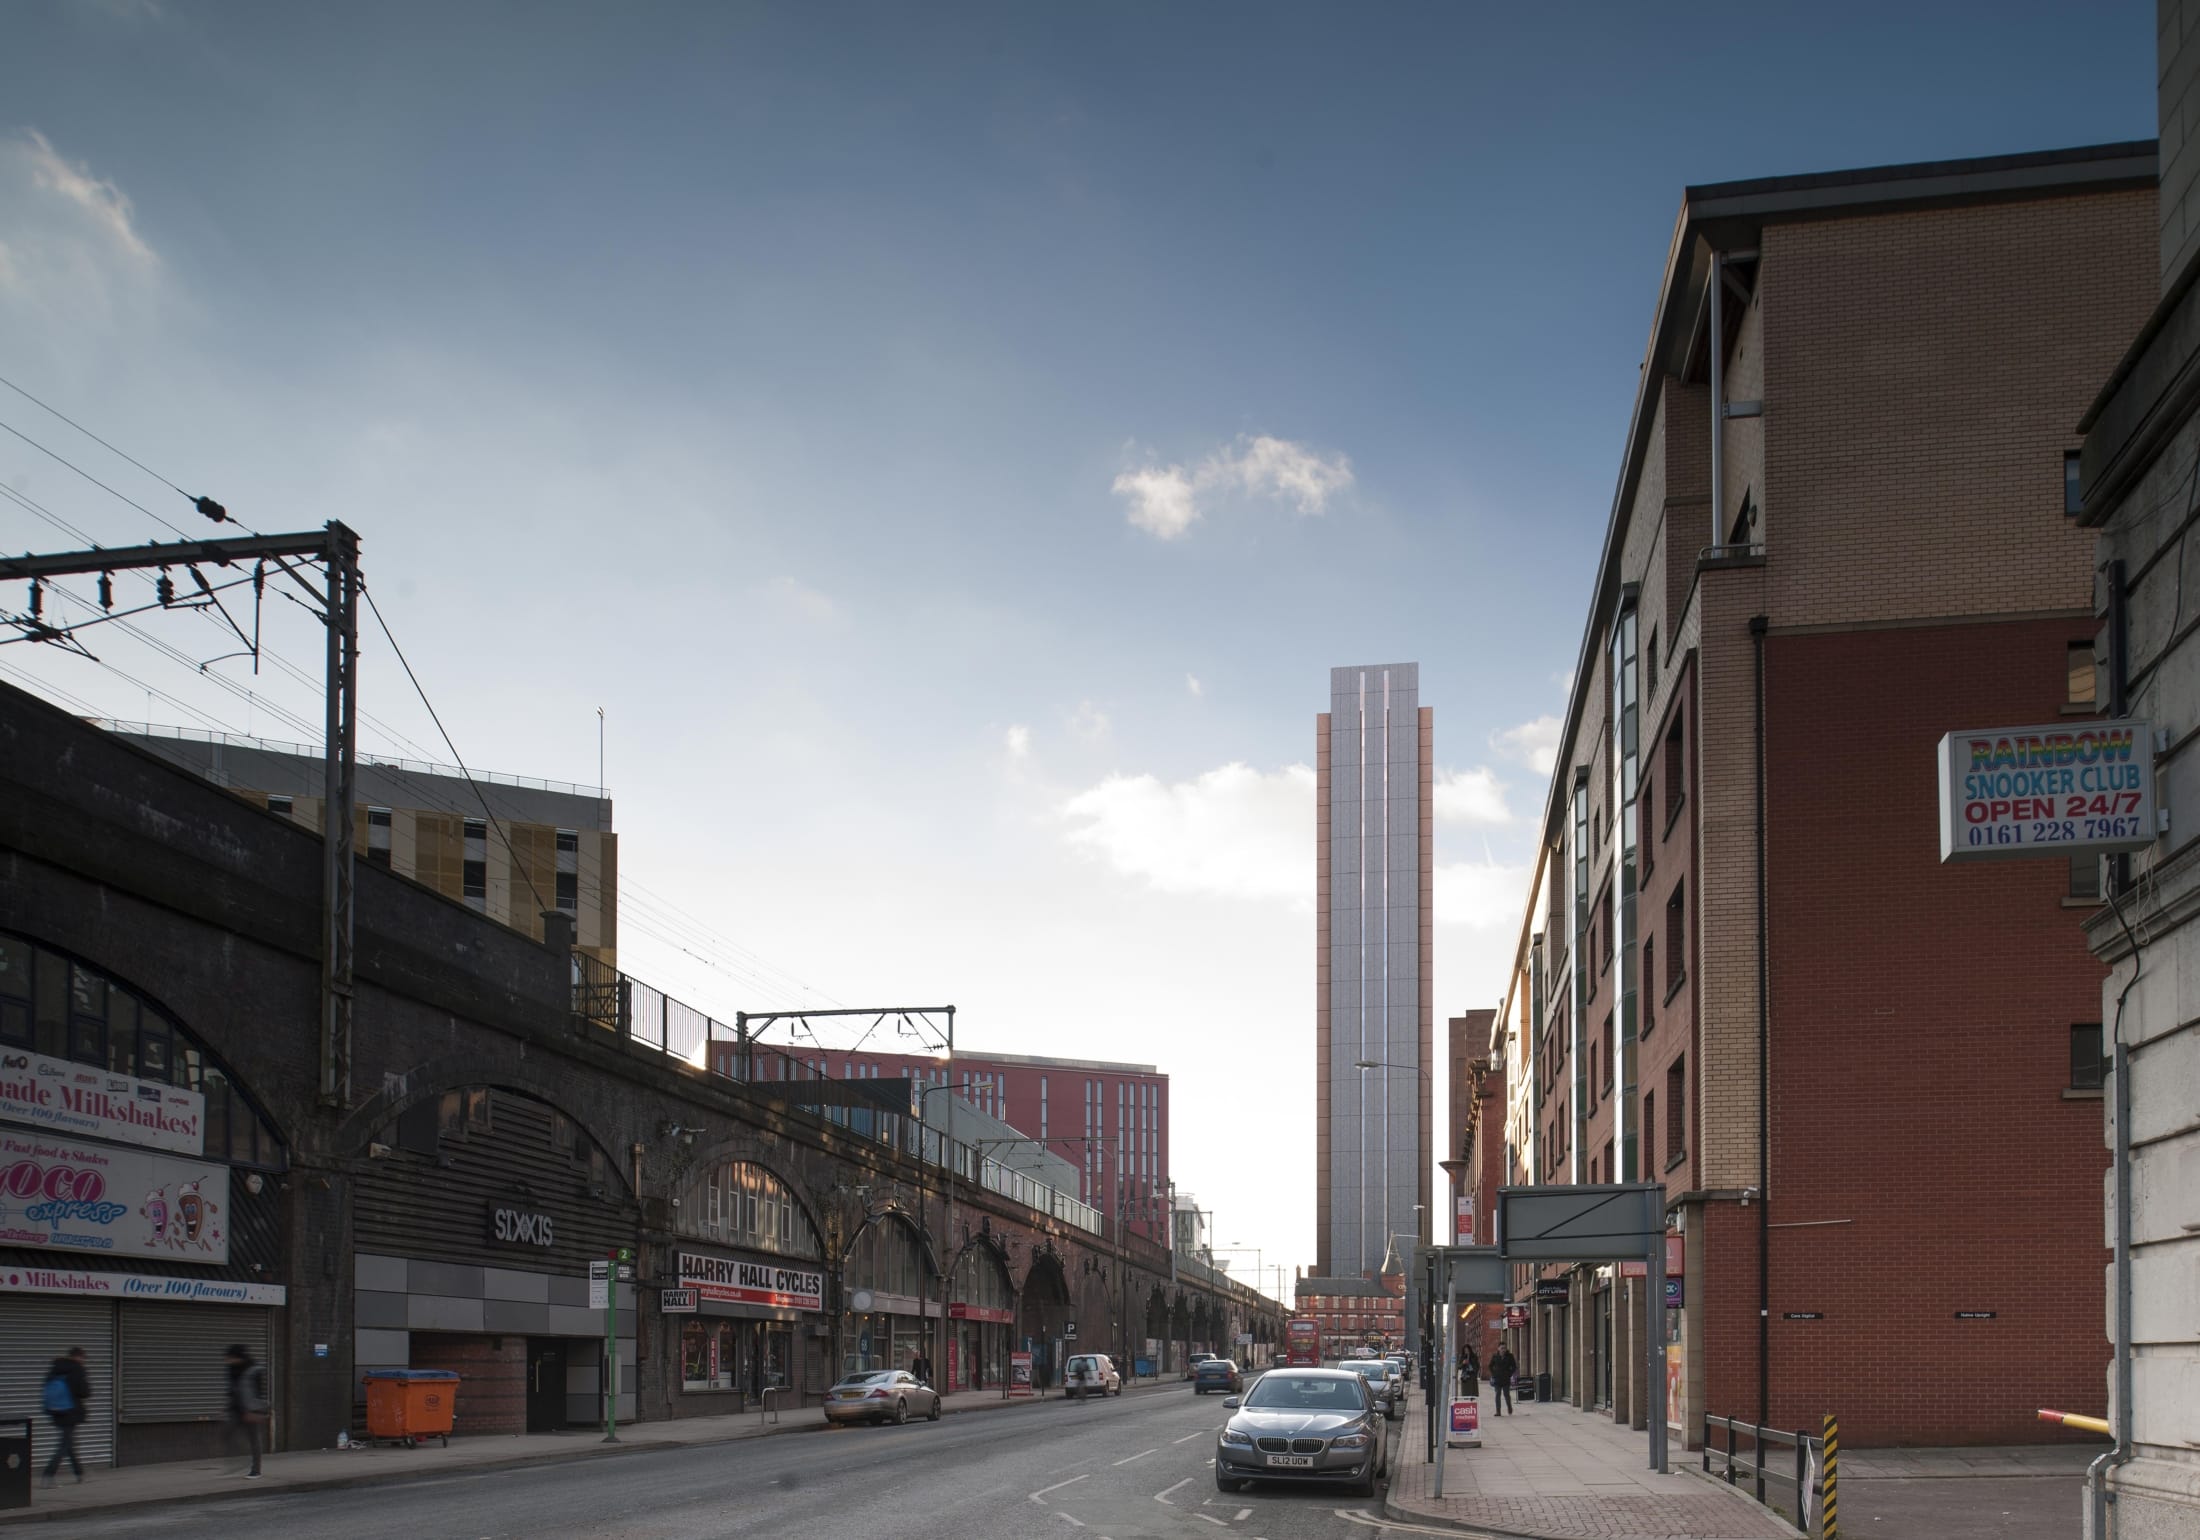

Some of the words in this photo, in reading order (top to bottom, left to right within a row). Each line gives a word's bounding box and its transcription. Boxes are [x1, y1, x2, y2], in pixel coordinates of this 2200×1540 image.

[1969, 729, 2133, 772] RAINBOW
[1965, 768, 2075, 800] SNOOKER
[2080, 764, 2141, 793] CLUB
[1965, 798, 2055, 824] OPEN
[2066, 792, 2142, 818] 24/7
[1968, 825, 2022, 846] 0161
[2033, 820, 2075, 842] 228
[2084, 817, 2140, 839] 7967
[0, 1078, 51, 1107] ade
[59, 1085, 198, 1137] Milkshakes!
[31, 1107, 53, 1120] 100
[4, 1140, 32, 1154] Fast
[71, 1151, 110, 1166] Shakes
[26, 1200, 127, 1230] express
[495, 1208, 553, 1247] SIXXIS
[621, 1250, 628, 1259] 2
[25, 1271, 110, 1290] Milkshakes
[123, 1278, 162, 1294] (Over
[165, 1280, 191, 1295] 100
[191, 1282, 248, 1301] flavours)
[682, 1255, 735, 1284] HARRY
[739, 1264, 772, 1289] HALL
[776, 1269, 820, 1296] CYCLES
[664, 1297, 689, 1307] HALL
[1454, 1405, 1477, 1415] cash
[1272, 1456, 1290, 1465] SL12
